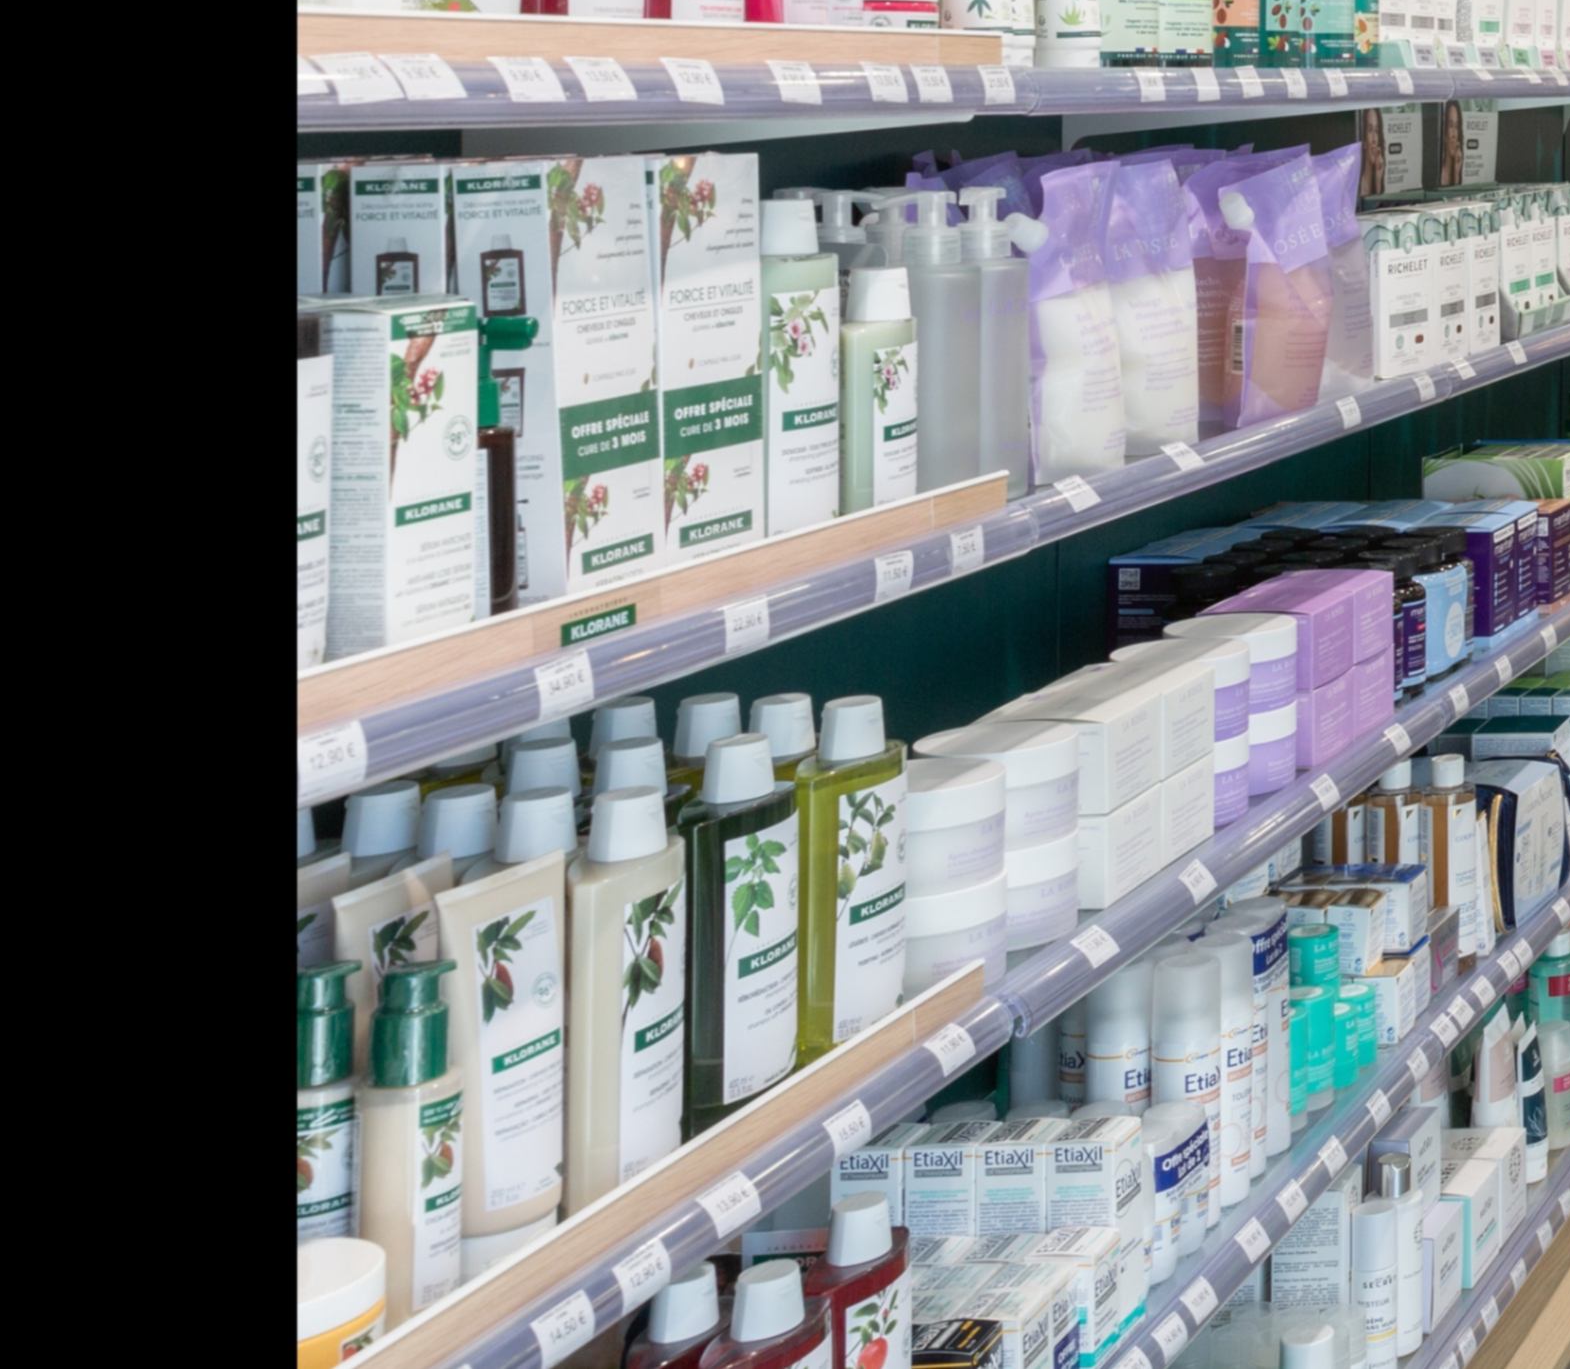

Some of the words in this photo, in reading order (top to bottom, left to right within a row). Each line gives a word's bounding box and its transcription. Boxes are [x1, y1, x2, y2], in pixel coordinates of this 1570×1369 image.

[355, 210, 391, 221] FORCE
[1387, 258, 1428, 275] RICHELET
[562, 296, 598, 316] FORCE
[609, 289, 646, 310] VITALITÉ
[670, 286, 706, 305] FORCE
[718, 280, 754, 300] VITALITÉ
[674, 403, 706, 421] OFFRE
[708, 392, 753, 414] SPÉCIALE
[571, 422, 603, 439] OFFRE
[604, 410, 650, 430] SPÉCIALE
[723, 411, 749, 428] MOIS
[620, 430, 647, 448] MOIS
[405, 496, 463, 520] KLORANE
[689, 515, 744, 540] KLORANE
[590, 540, 646, 567] KLORANE
[570, 611, 629, 640] KLORANE
[503, 1034, 558, 1067] KLORANE
[913, 1149, 963, 1170] EtiaXil
[984, 1148, 1034, 1169] EtiaXil
[1054, 1144, 1103, 1165] EtiaXil
